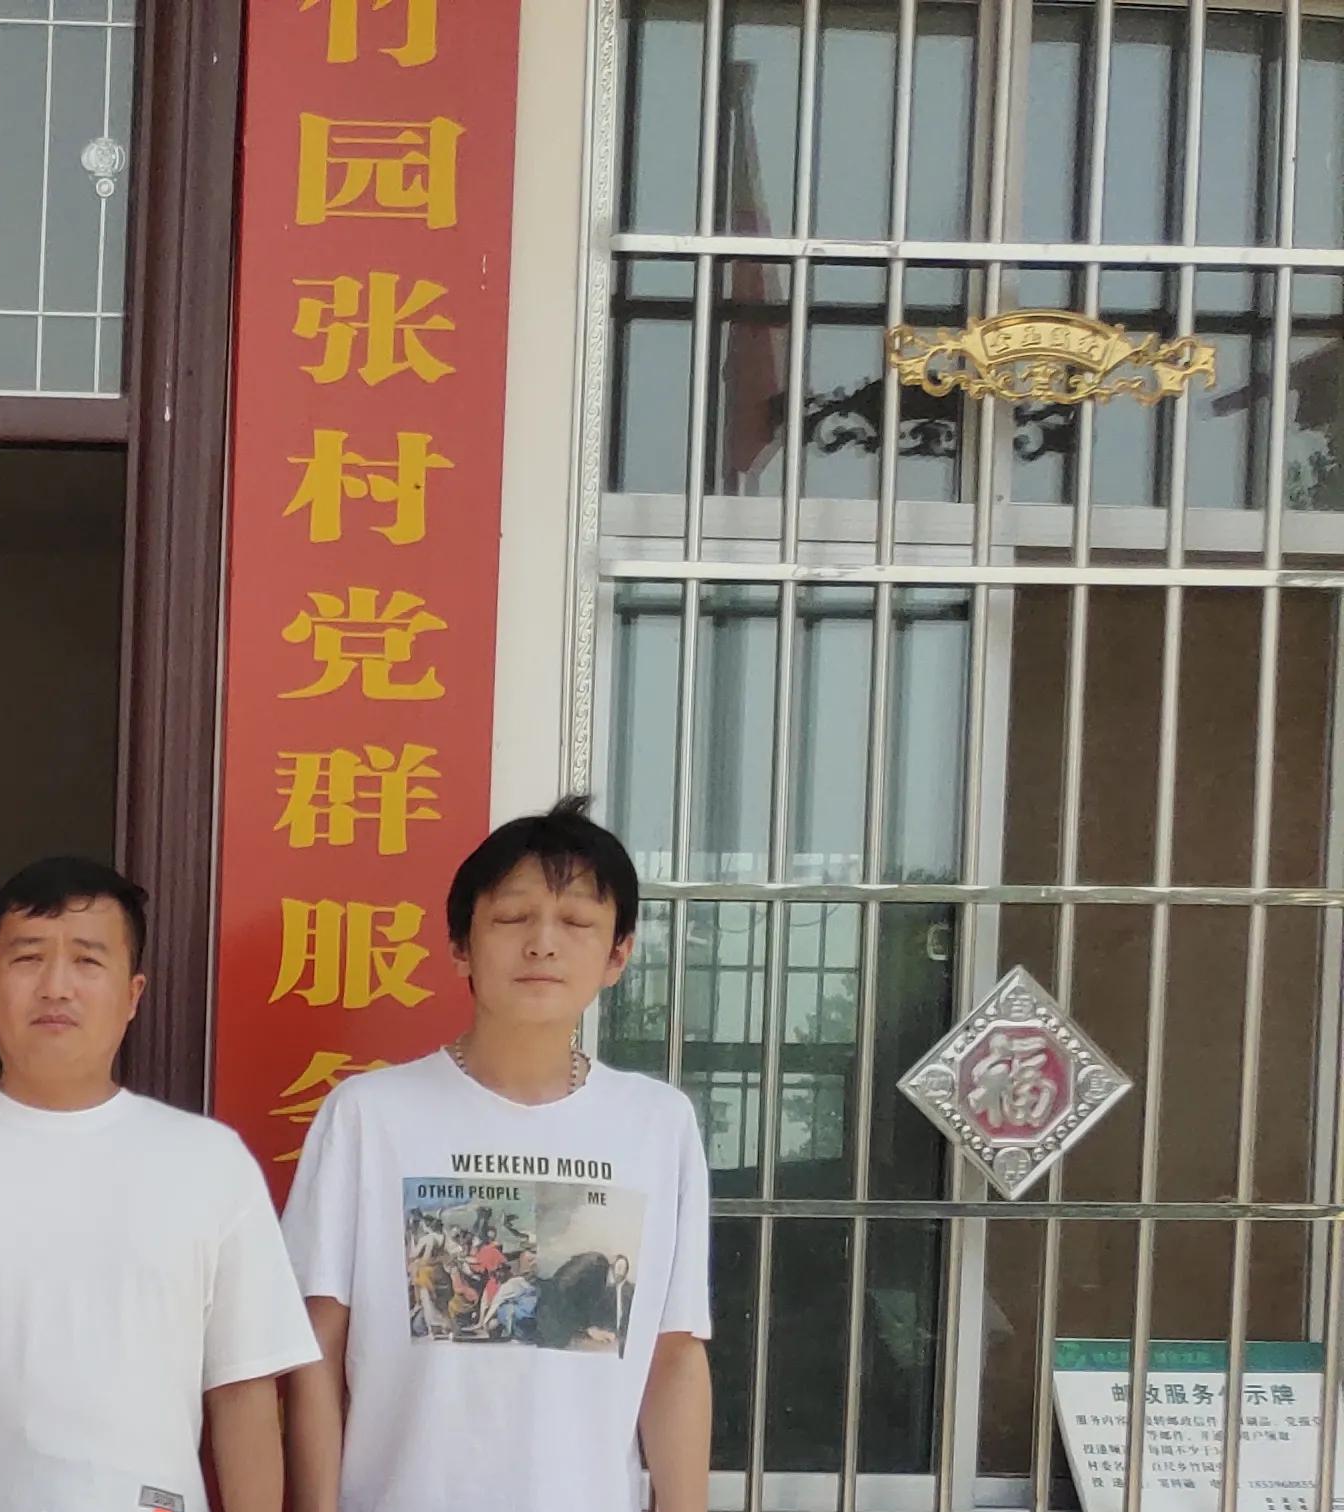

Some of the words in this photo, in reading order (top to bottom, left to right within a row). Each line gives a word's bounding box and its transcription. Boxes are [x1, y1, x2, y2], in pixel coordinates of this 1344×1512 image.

[967, 1033, 1058, 1127] 福
[451, 1154, 550, 1176] WEEKEND
[557, 1157, 613, 1180] MOOD
[417, 1184, 464, 1199] OTHER
[468, 1186, 521, 1201] PEOPLE
[587, 1191, 608, 1206] ME
